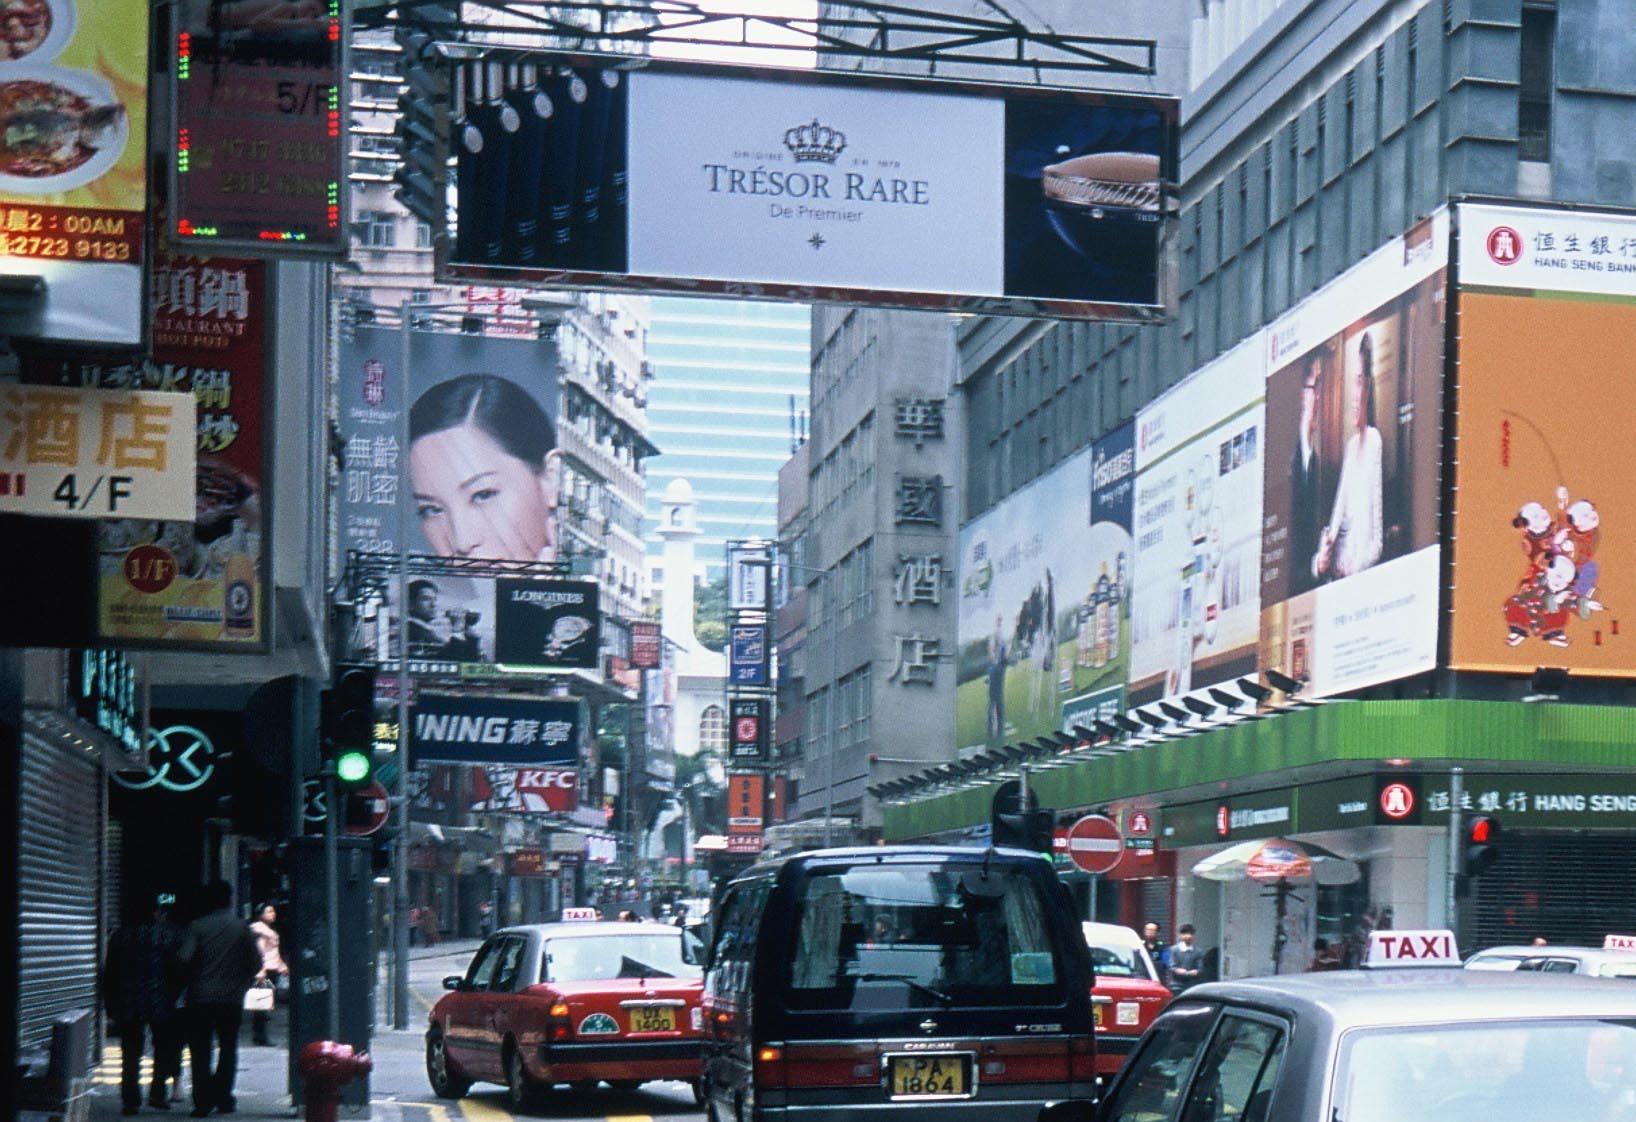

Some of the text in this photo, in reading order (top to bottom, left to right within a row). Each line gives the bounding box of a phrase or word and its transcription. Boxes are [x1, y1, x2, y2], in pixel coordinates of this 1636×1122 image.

[704, 165, 929, 205] TRÉSOR RARE
[770, 203, 864, 222] De Premier
[74, 240, 130, 260] 9133
[1535, 259, 1568, 269] HANG
[1572, 260, 1603, 271] SENG
[4, 391, 173, 472] 酒店
[53, 474, 134, 511] 4/F
[131, 557, 170, 581] 1/F
[512, 589, 584, 604] LONGINES
[518, 771, 575, 789] KFC
[1535, 794, 1586, 812] HANG
[566, 911, 593, 919] TAXI
[1379, 936, 1452, 960] TAXI
[914, 1058, 943, 1076] PA
[903, 1076, 954, 1093] 1864
